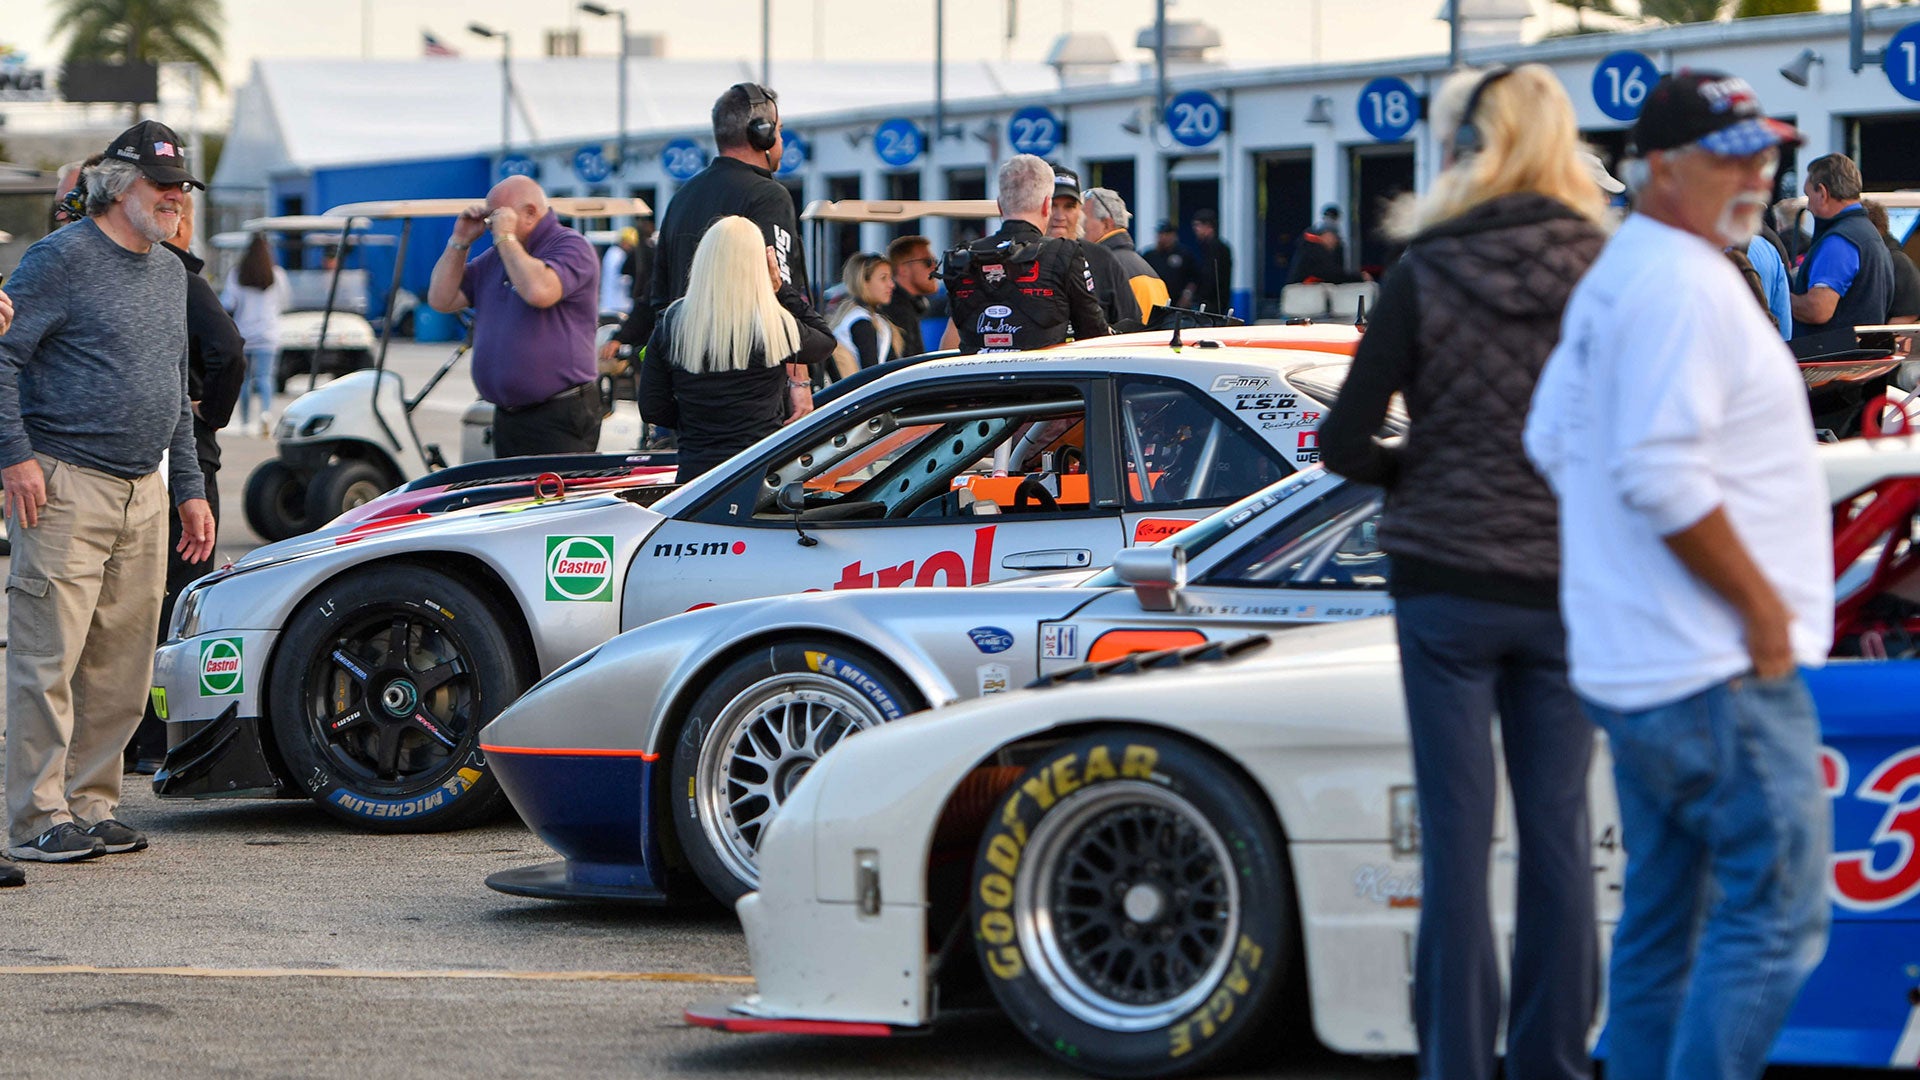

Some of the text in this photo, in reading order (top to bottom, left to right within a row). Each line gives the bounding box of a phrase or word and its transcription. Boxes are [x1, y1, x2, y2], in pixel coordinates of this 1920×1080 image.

[1605, 67, 1648, 106] 16
[1174, 102, 1219, 135] 20
[1369, 91, 1410, 128] 18
[882, 128, 917, 155] 24
[1014, 117, 1056, 145] 22
[669, 147, 702, 171] 28
[1235, 399, 1298, 410] L.S.D.
[1257, 411, 1320, 420] GT-R
[1154, 526, 1184, 534] AU
[558, 559, 607, 575] Castrol
[319, 598, 336, 618] LF
[1220, 606, 1239, 614] ST.
[1242, 606, 1290, 616] JAMES
[1325, 608, 1364, 616] BRAD
[1045, 627, 1056, 656] IMSA
[206, 658, 239, 672] Castrol
[839, 665, 900, 720] MICHEL
[983, 680, 1006, 689] 24
[338, 791, 444, 817] MICHELIN
[980, 744, 1160, 980] GOODYEAR
[1169, 933, 1263, 1057] EAGLE
